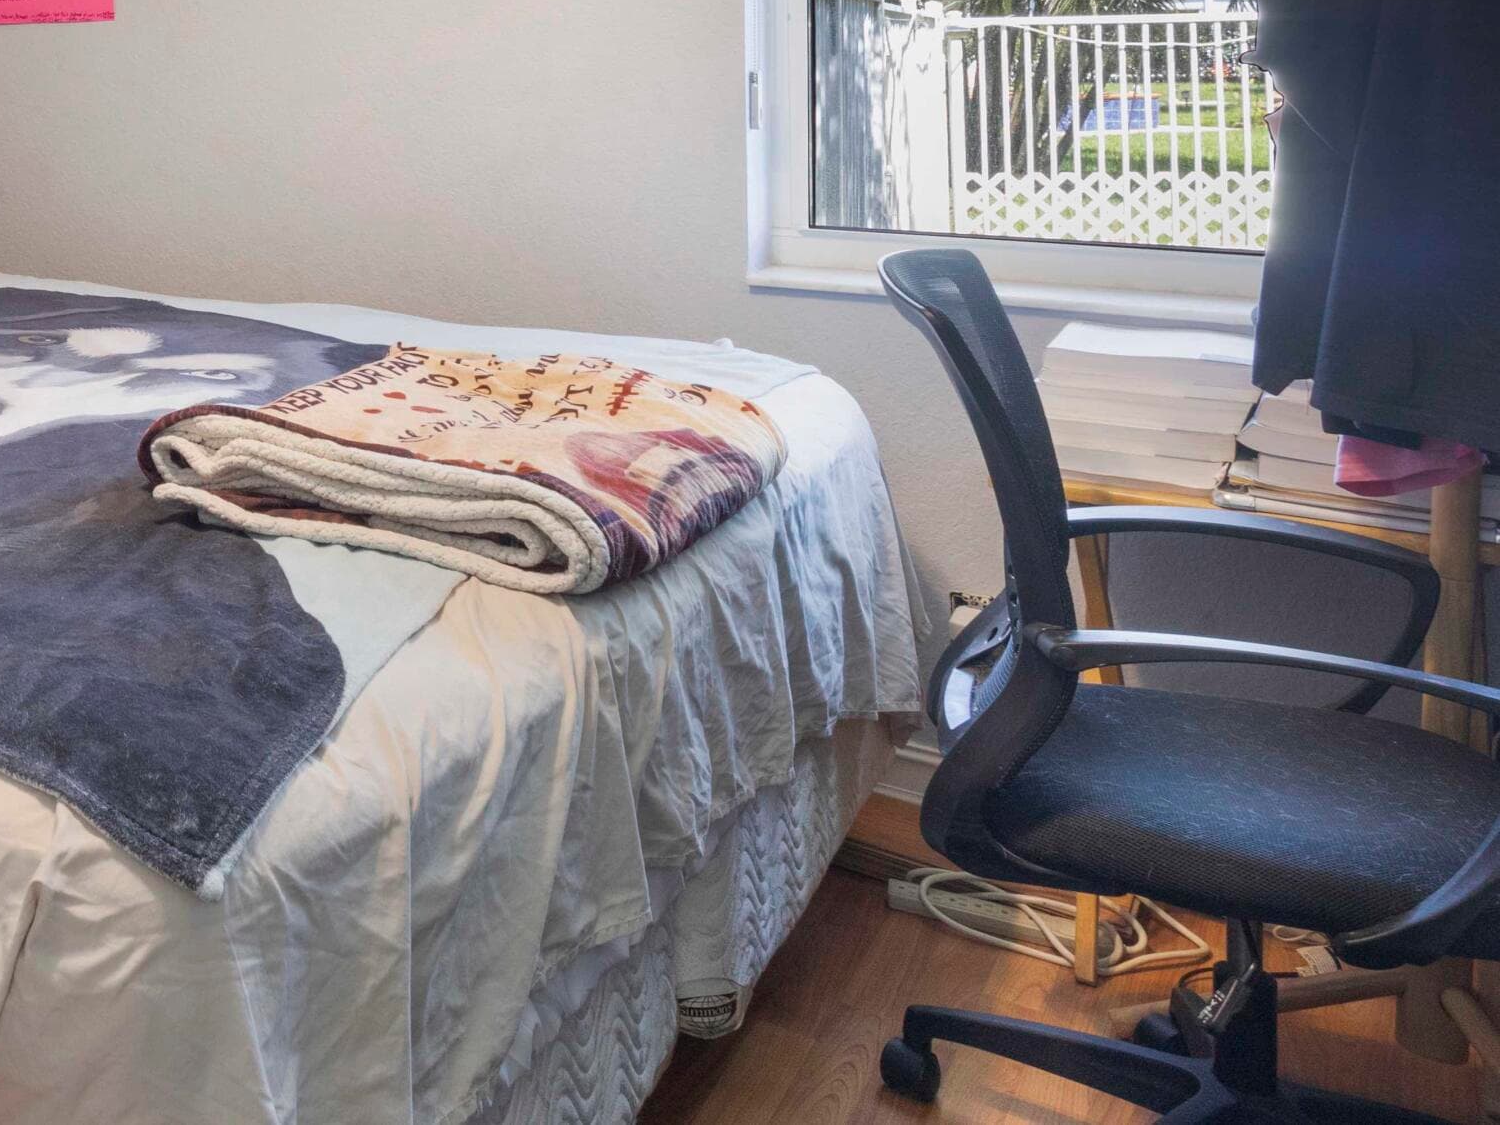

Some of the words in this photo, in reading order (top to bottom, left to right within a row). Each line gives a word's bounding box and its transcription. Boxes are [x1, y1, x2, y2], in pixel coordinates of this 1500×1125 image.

[271, 388, 328, 416] KEEP
[322, 367, 388, 396] YOUR
[415, 373, 460, 389] TO
